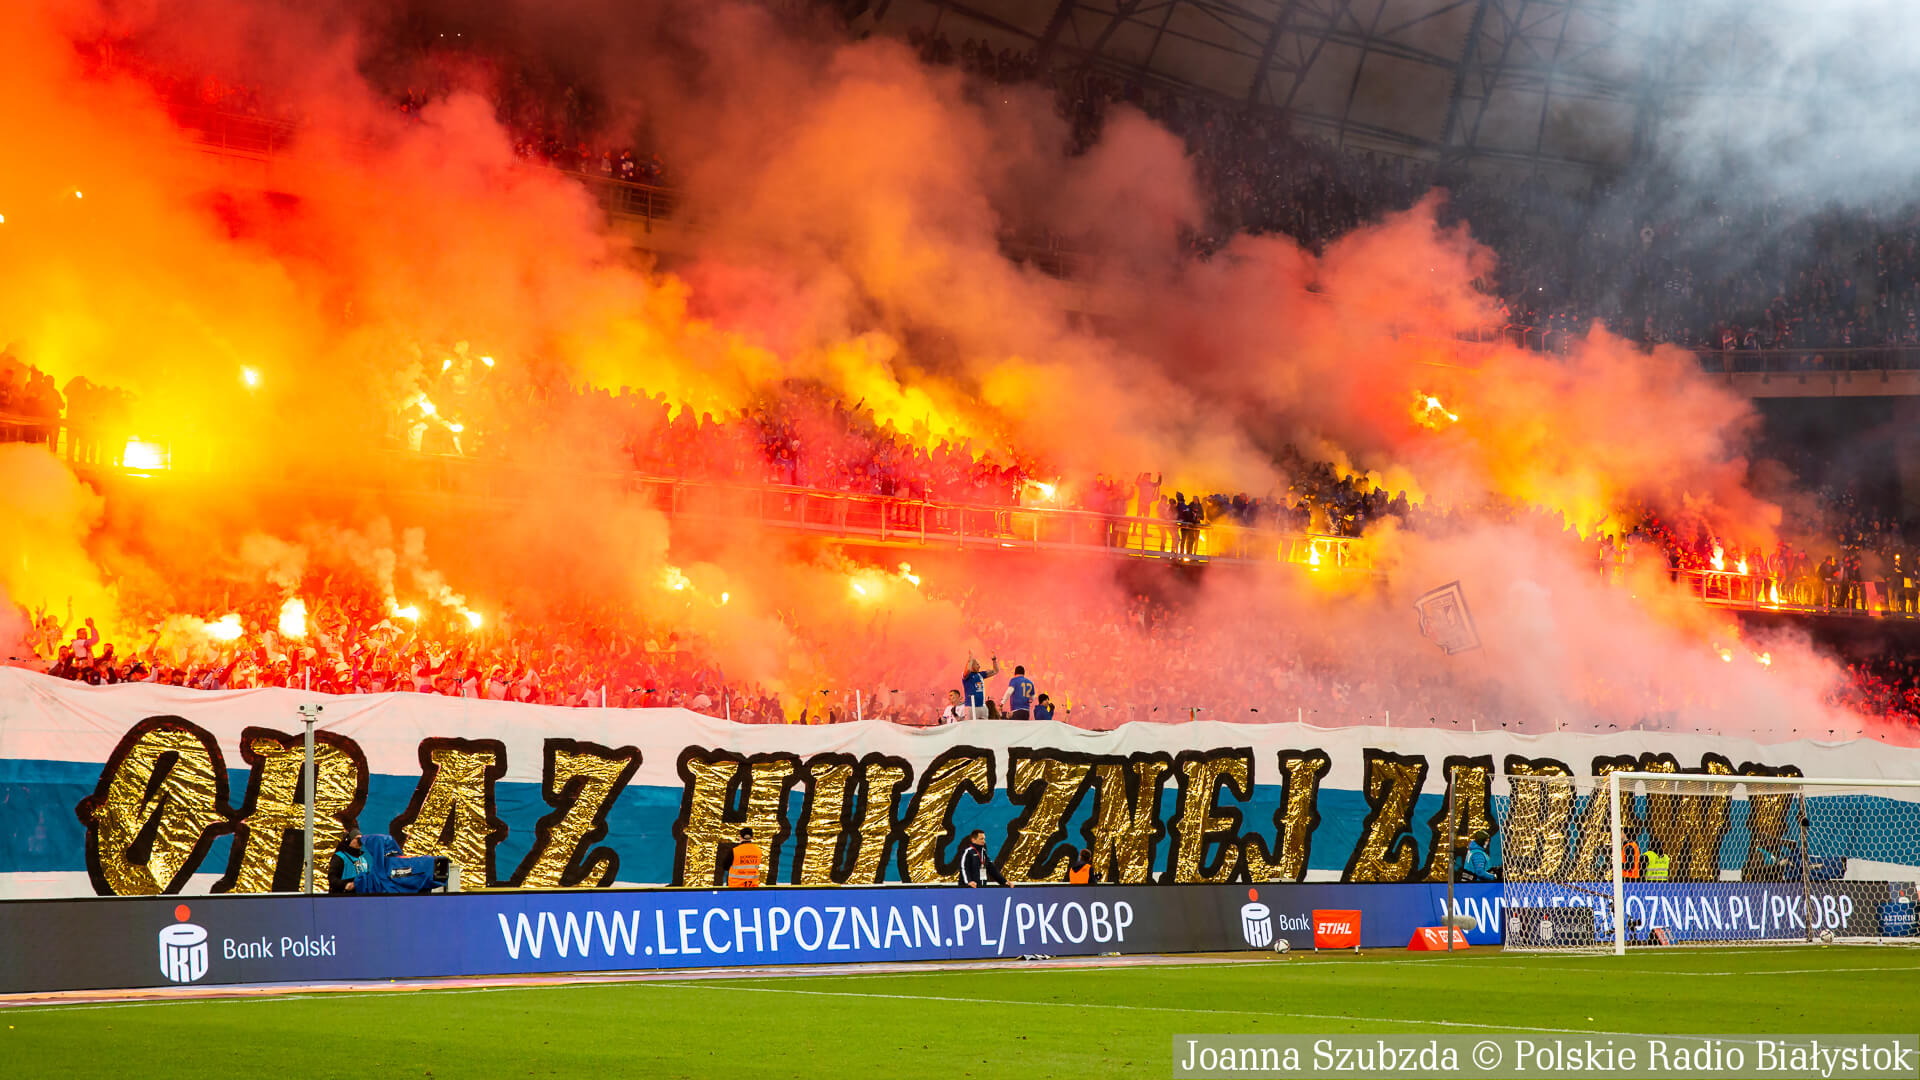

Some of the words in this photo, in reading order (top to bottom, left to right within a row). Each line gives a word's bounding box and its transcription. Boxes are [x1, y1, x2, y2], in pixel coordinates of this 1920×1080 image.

[1020, 682, 1033, 698] 12
[75, 715, 642, 895] ORAZ
[672, 744, 1332, 887] HUCZNEJ
[498, 896, 1134, 959] WWW.LECHPOZNAN.PL/PKOBP
[1279, 913, 1311, 931] Bank
[1317, 922, 1353, 935] STIHL
[159, 923, 209, 983] PKO
[223, 936, 273, 959] Bank
[281, 934, 336, 958] Polski
